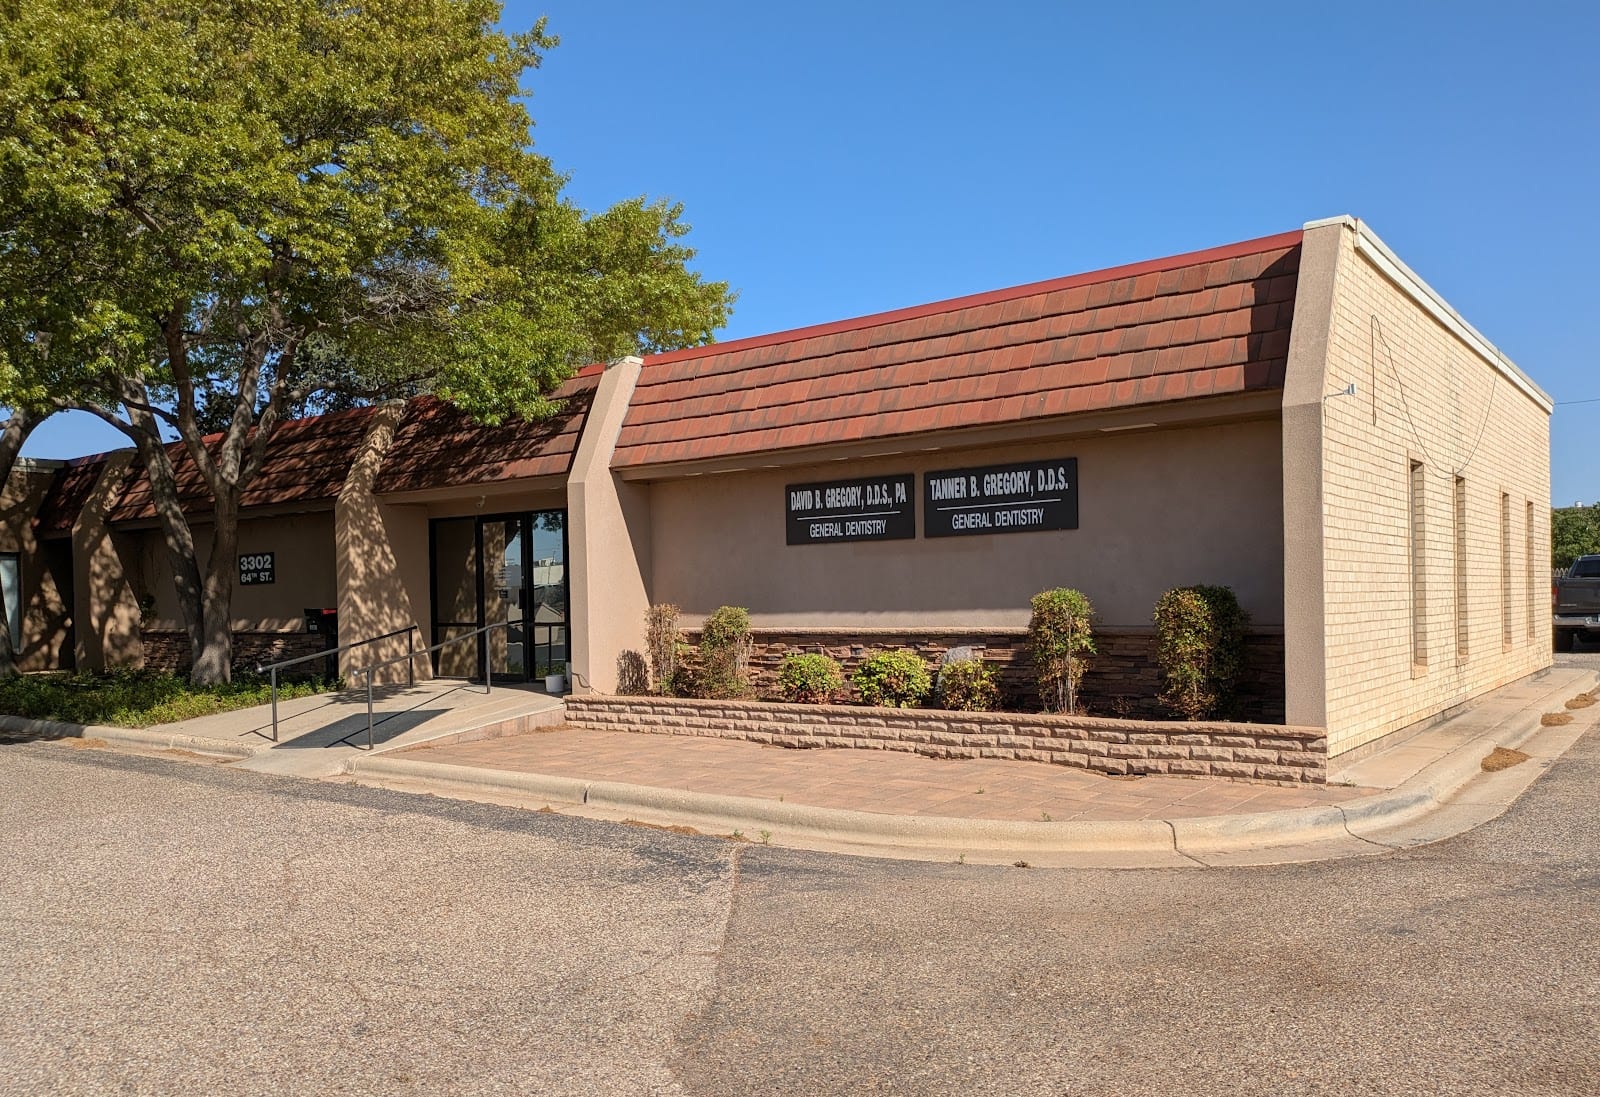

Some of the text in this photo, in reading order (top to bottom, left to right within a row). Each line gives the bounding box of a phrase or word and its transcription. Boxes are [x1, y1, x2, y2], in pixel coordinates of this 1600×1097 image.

[930, 466, 1069, 500] TANNER B. GREGORY, D.D.S.
[791, 482, 907, 511] DAVID B. GREGORY, D.D.S., PA
[952, 508, 1044, 529] GENERAL DENTISTRY
[810, 520, 887, 537] GENERAL DENTISTRY
[240, 555, 271, 571] 3302
[260, 572, 272, 581] ST.
